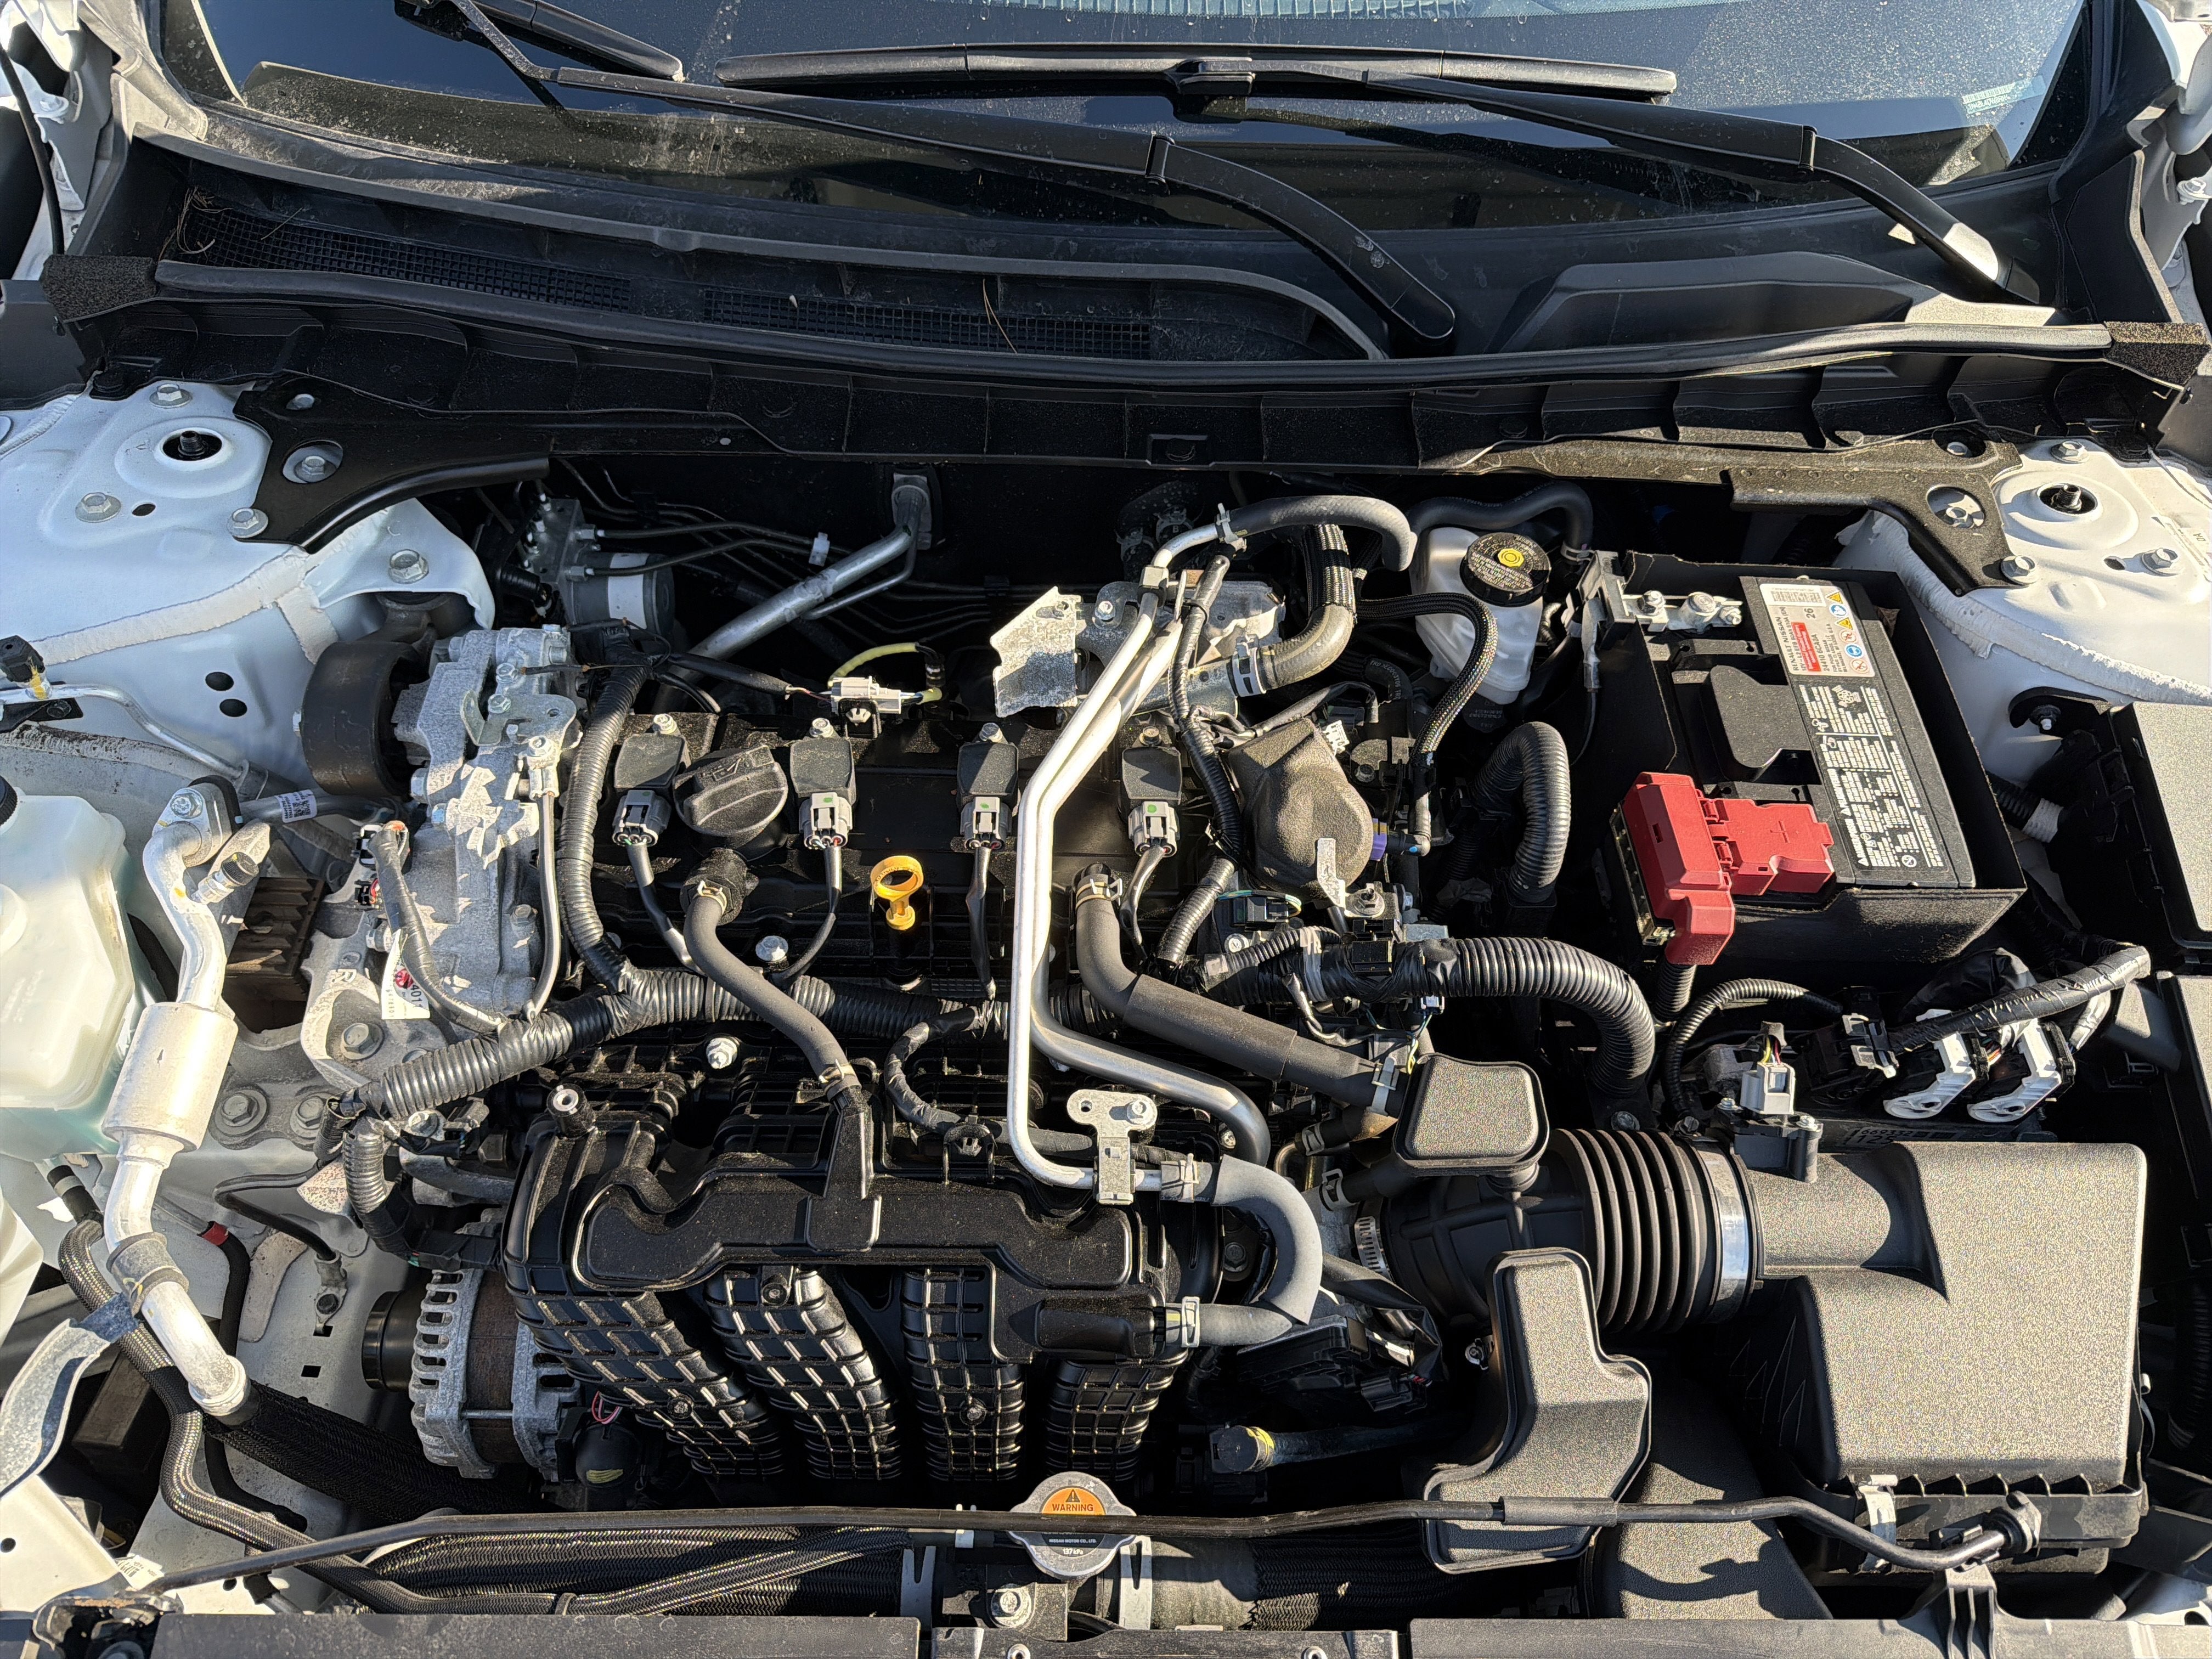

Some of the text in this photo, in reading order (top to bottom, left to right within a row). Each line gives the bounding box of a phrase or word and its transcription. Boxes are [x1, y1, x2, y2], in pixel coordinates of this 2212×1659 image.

[1803, 608, 1816, 618] 26
[1774, 616, 1799, 670] RENAULT NISSAN
[1861, 1128, 1914, 1137] 669332
[1858, 1135, 1897, 1144] 125
